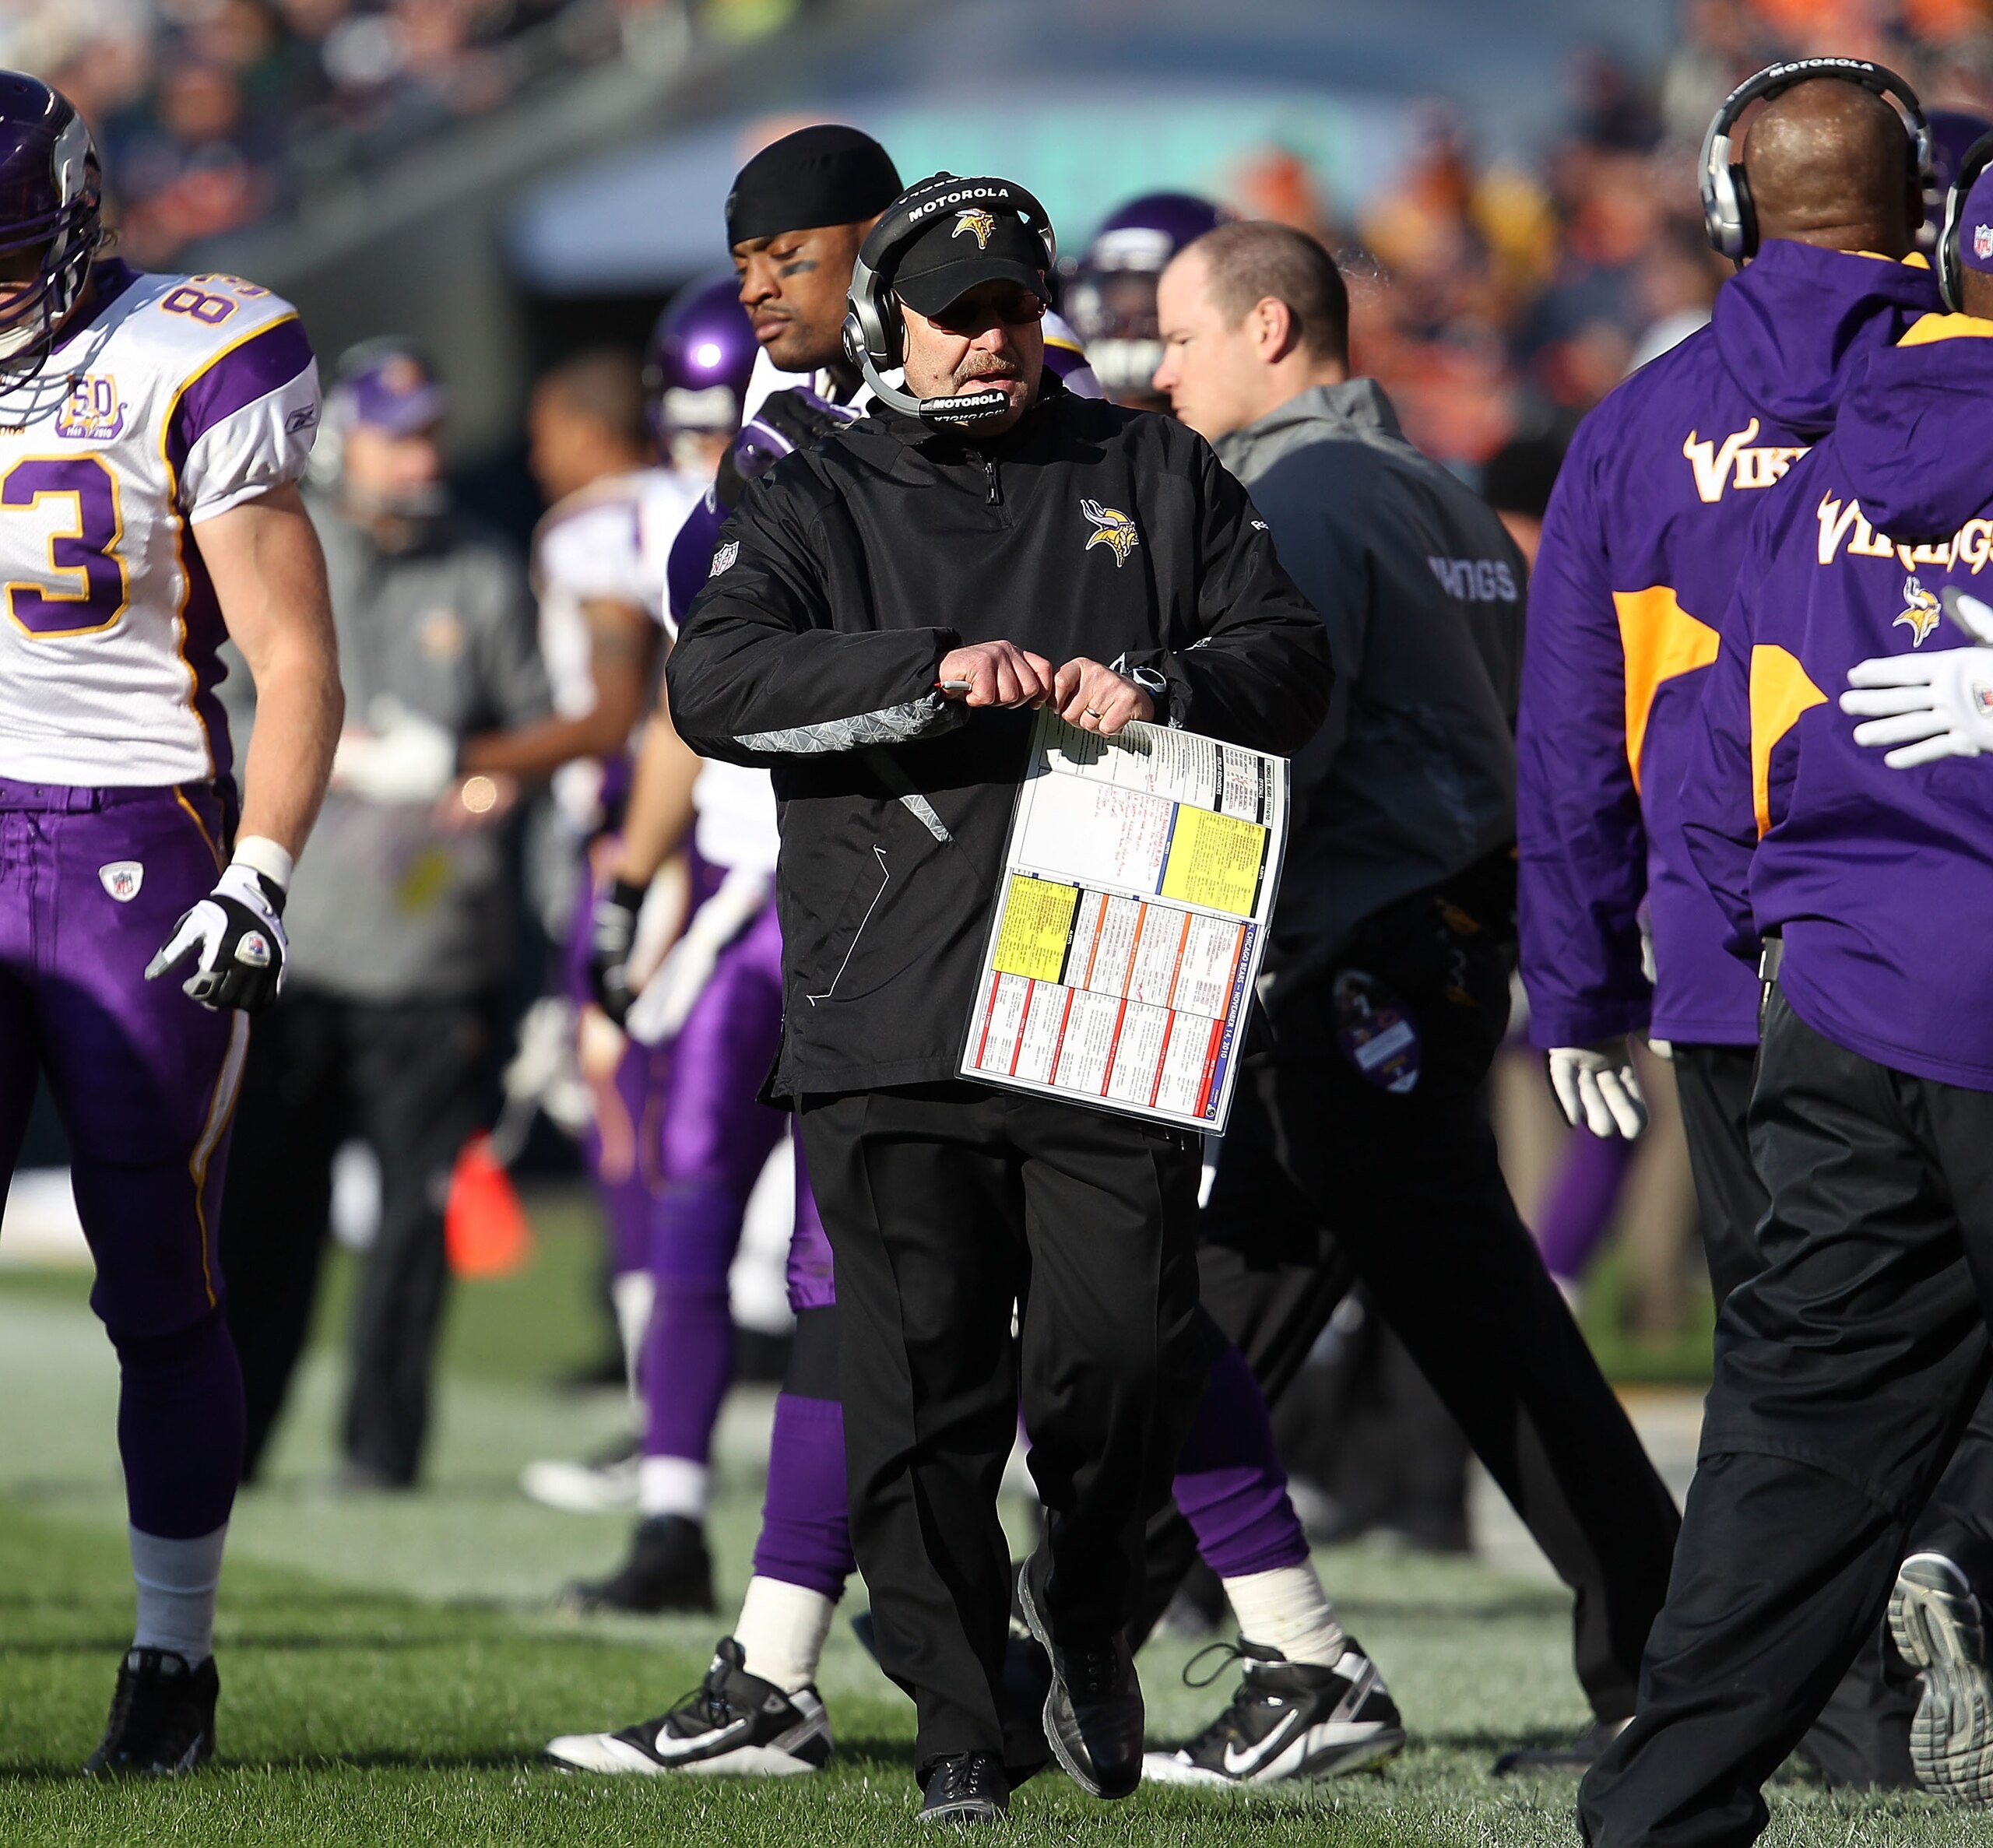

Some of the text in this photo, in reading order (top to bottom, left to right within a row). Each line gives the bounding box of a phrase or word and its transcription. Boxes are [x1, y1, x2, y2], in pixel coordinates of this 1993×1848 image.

[1769, 58, 1874, 78] MOTOROLA
[908, 187, 1009, 223] MOTOROLA
[72, 380, 111, 416] 50
[932, 391, 1005, 410] MOTOROLA
[1682, 416, 1813, 504] VIK
[0, 451, 130, 638] 3
[714, 553, 733, 572] NFL
[1241, 930, 1253, 962] CHICAGO
[1236, 961, 1246, 984] BEARS
[1227, 990, 1240, 1028] NOVEMBER
[1223, 1028, 1232, 1040] 14,
[1219, 1041, 1229, 1059] 2010
